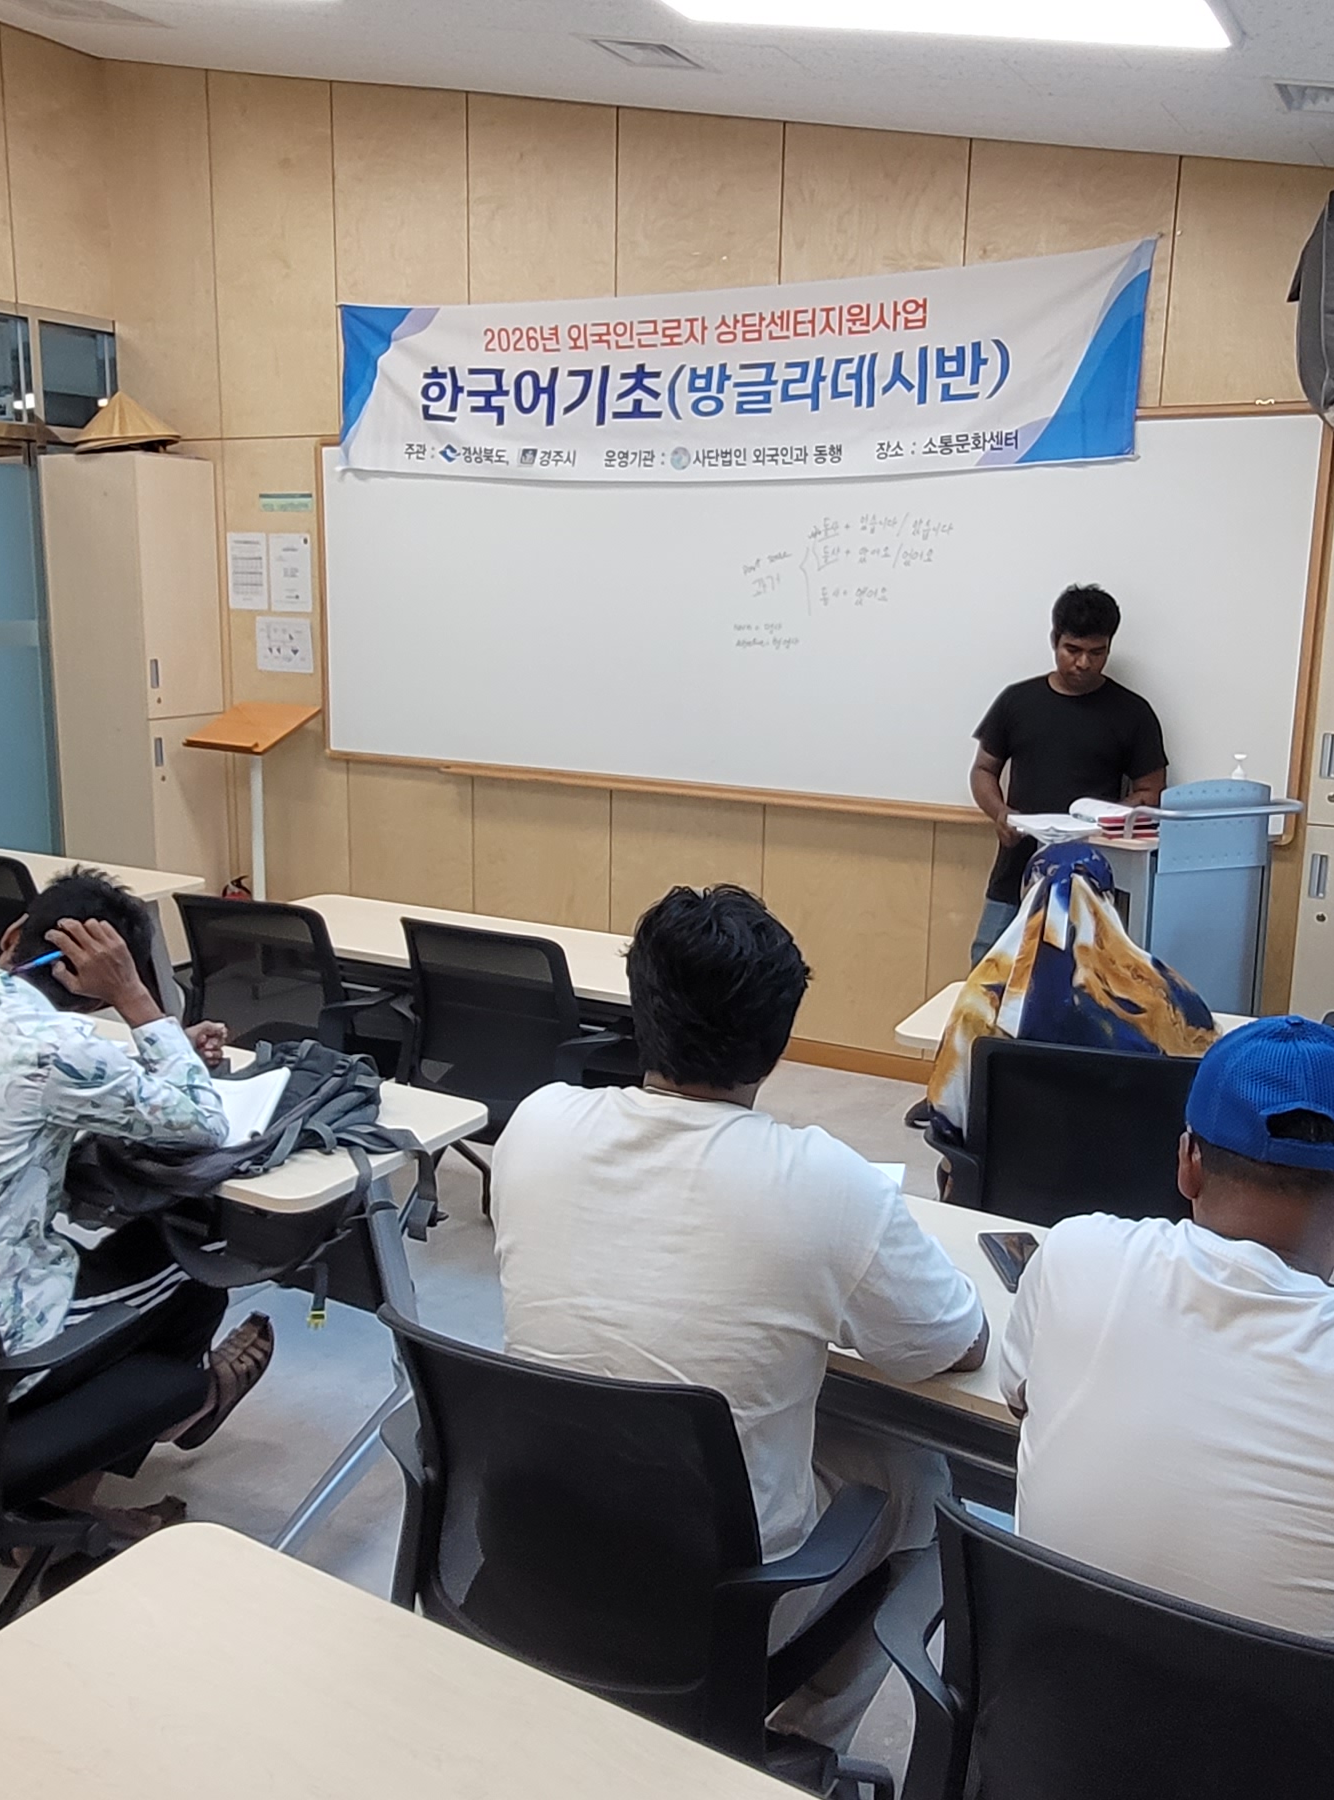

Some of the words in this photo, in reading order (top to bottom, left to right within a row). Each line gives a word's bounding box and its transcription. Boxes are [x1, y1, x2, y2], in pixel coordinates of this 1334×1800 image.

[483, 325, 562, 353] 2026년
[567, 315, 709, 352] 외국인근로자
[714, 297, 929, 345] 상담센터지원사업
[420, 338, 1011, 427] 한국어기초(방글라데시반)
[404, 443, 427, 461] 주관
[539, 449, 577, 467] 경주시
[604, 449, 656, 468] 운영기관
[692, 447, 747, 468] 사단법인
[752, 445, 809, 467] 외국인과
[813, 443, 843, 465] 동행
[875, 440, 904, 461] 장소
[921, 429, 1020, 456] 소통문화센터
